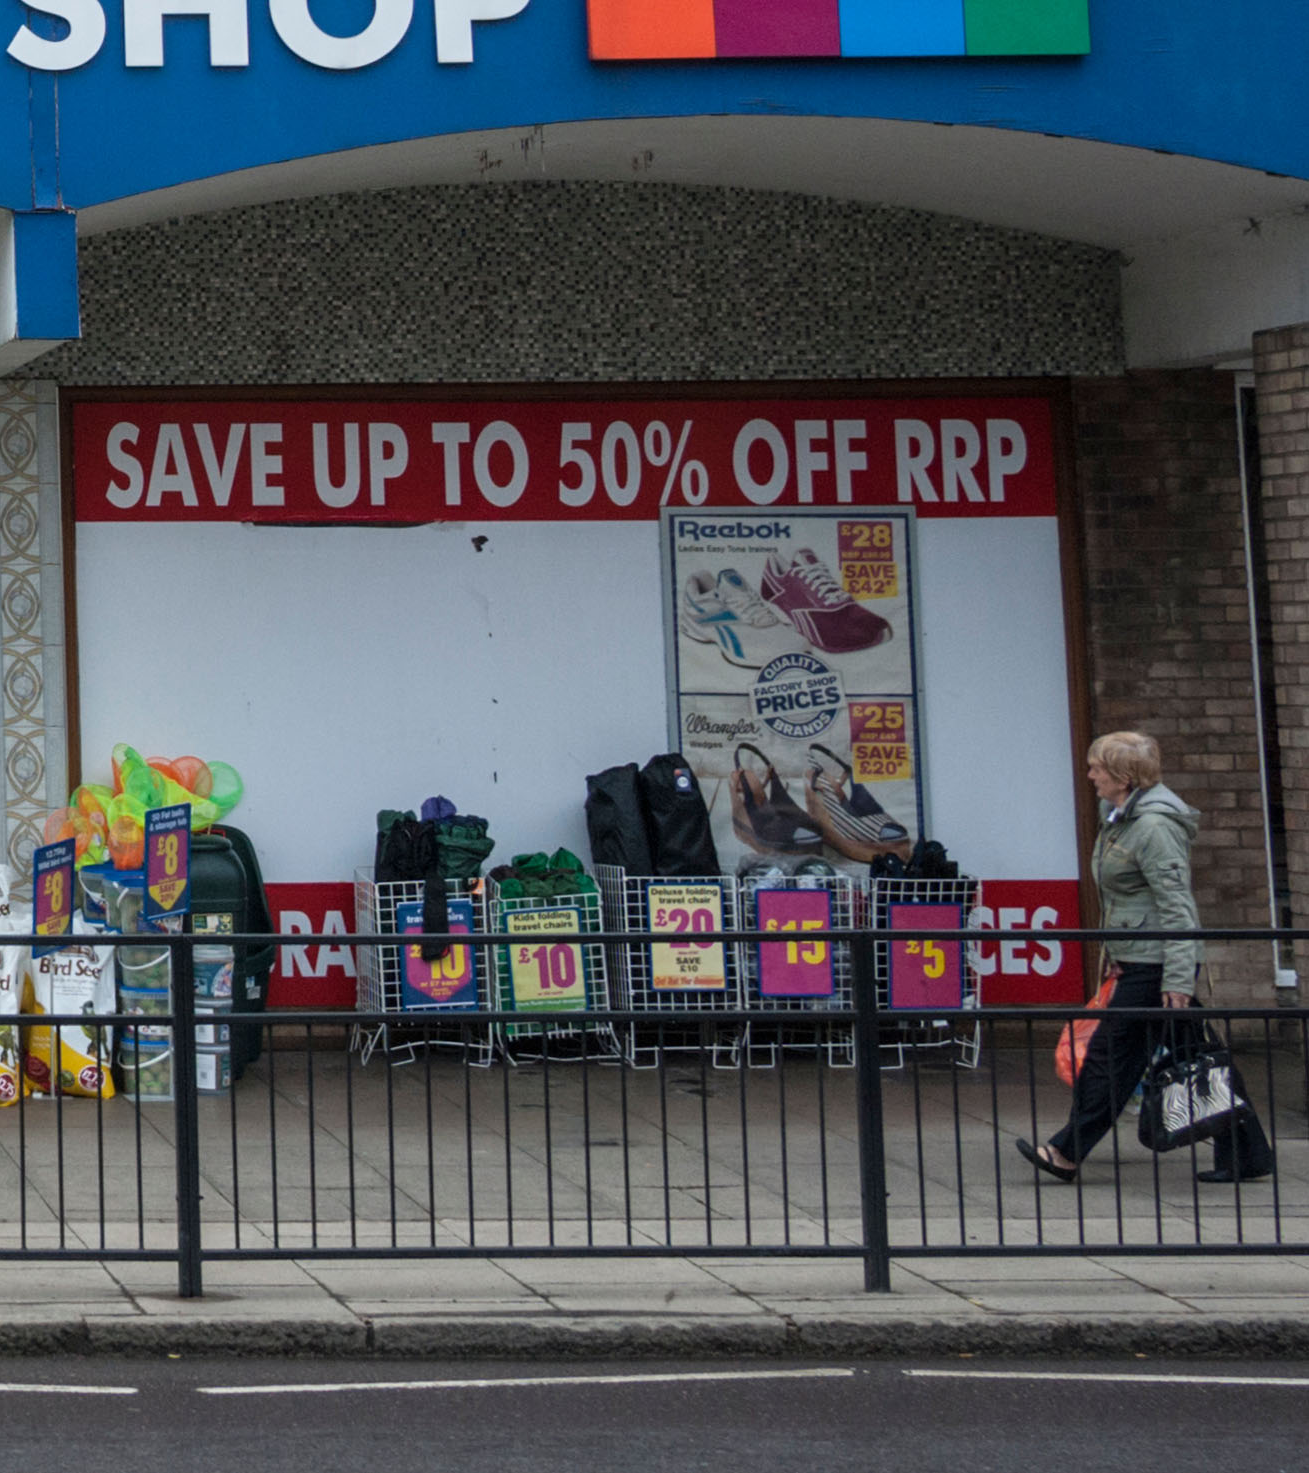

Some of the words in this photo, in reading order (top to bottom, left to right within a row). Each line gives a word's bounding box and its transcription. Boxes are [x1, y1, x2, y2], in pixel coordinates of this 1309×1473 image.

[105, 421, 285, 509] SAVE
[312, 422, 409, 508] UP
[431, 420, 530, 508] TO
[558, 419, 711, 508] 50%
[732, 418, 868, 506] OFF
[894, 418, 1028, 503] RRP
[678, 521, 791, 541] Reebok
[840, 525, 891, 547] £28
[678, 545, 704, 553] Ladies
[707, 546, 726, 555] Easy
[748, 545, 779, 554] trainers
[845, 564, 895, 579] SAVE
[764, 656, 821, 680] QUALITY
[753, 679, 803, 696] FACTORY
[806, 675, 837, 689] SHOP
[756, 685, 841, 716] PRICES
[685, 712, 760, 741] Wrangler
[772, 712, 833, 737] BRANDS
[852, 706, 903, 729] £25
[689, 741, 723, 749] Wedges
[856, 745, 907, 760] SAVE
[156, 833, 178, 875] £8
[44, 871, 63, 913] £8
[651, 888, 683, 896] Deluxe
[685, 887, 718, 896] folding
[659, 896, 685, 904] travel
[687, 896, 711, 904] chair
[514, 923, 541, 931] travel
[544, 920, 573, 930] chairs
[538, 911, 571, 920] folding
[654, 908, 715, 949] £20
[766, 919, 827, 965] £15
[76, 959, 102, 978] See
[518, 943, 577, 990] £10
[676, 957, 701, 965] SAVE
[905, 939, 945, 979] £5
